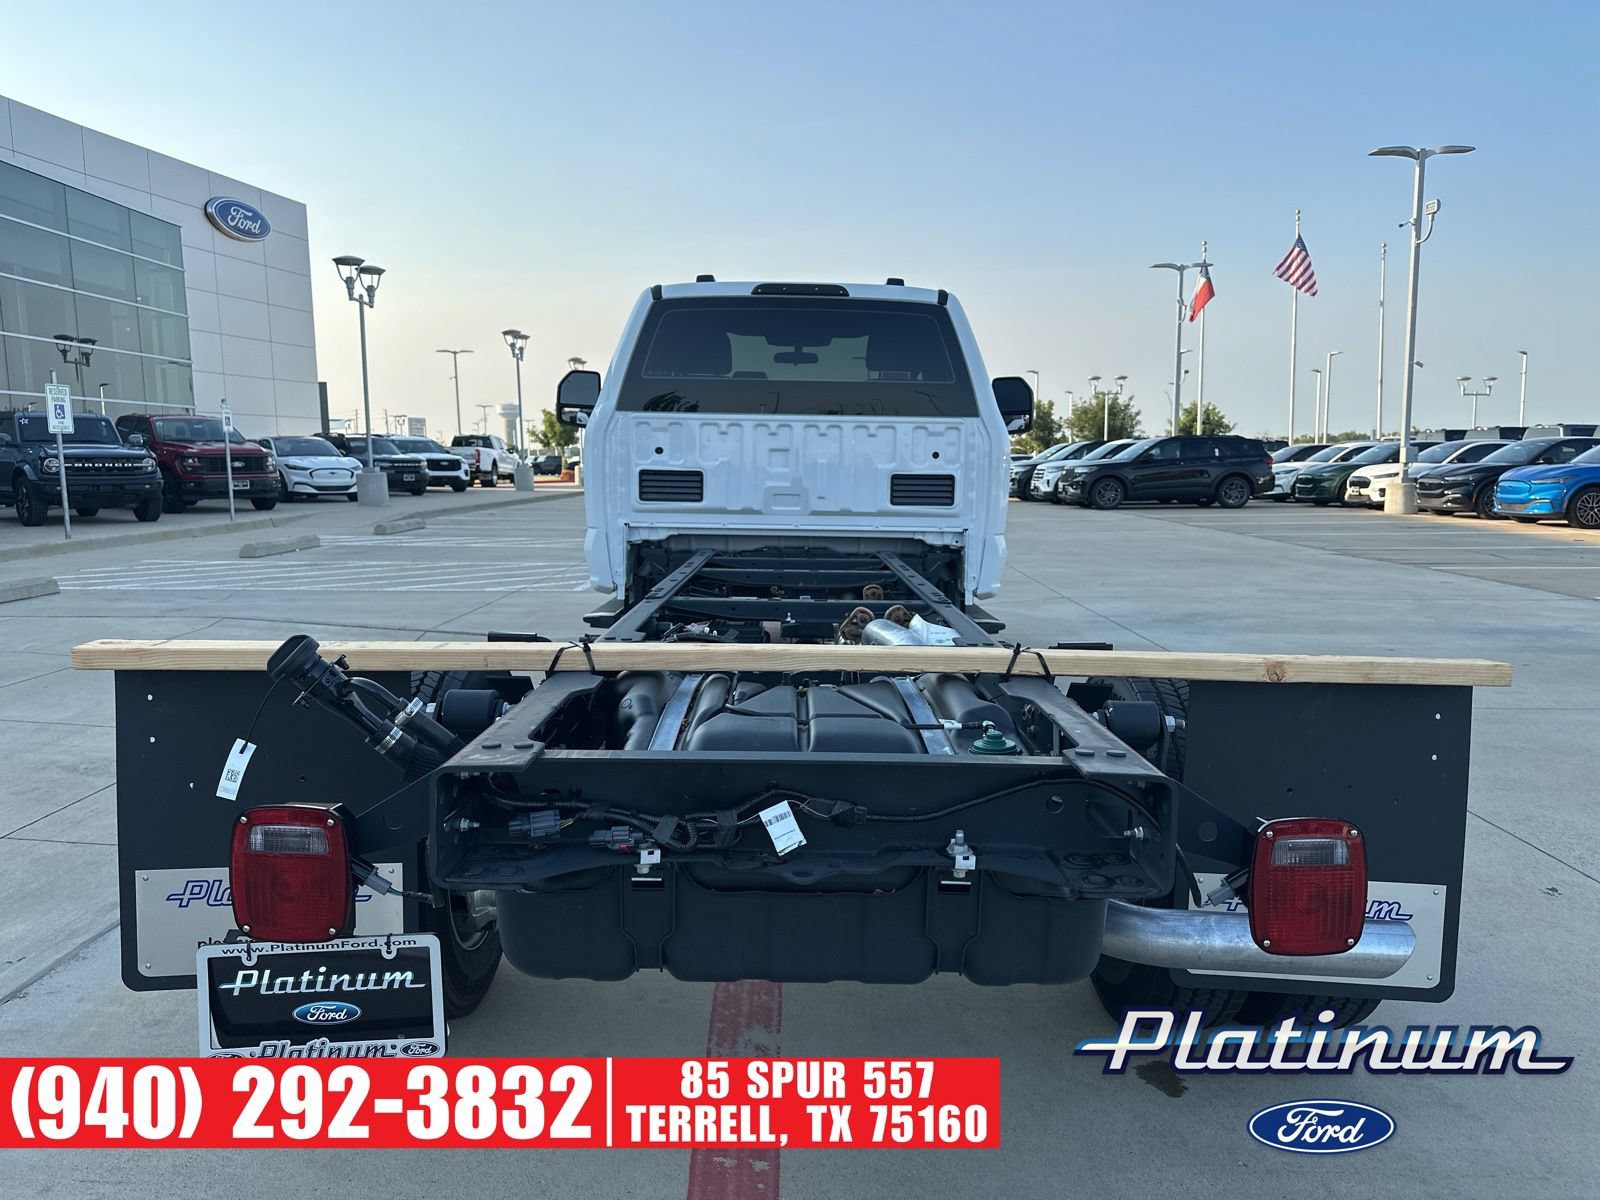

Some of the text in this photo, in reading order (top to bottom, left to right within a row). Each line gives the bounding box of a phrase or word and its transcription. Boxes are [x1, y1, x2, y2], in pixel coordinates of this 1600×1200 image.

[227, 206, 261, 233] Ford
[218, 966, 426, 996] Platinum
[305, 1004, 348, 1022] Ford
[407, 1042, 433, 1055] Ford
